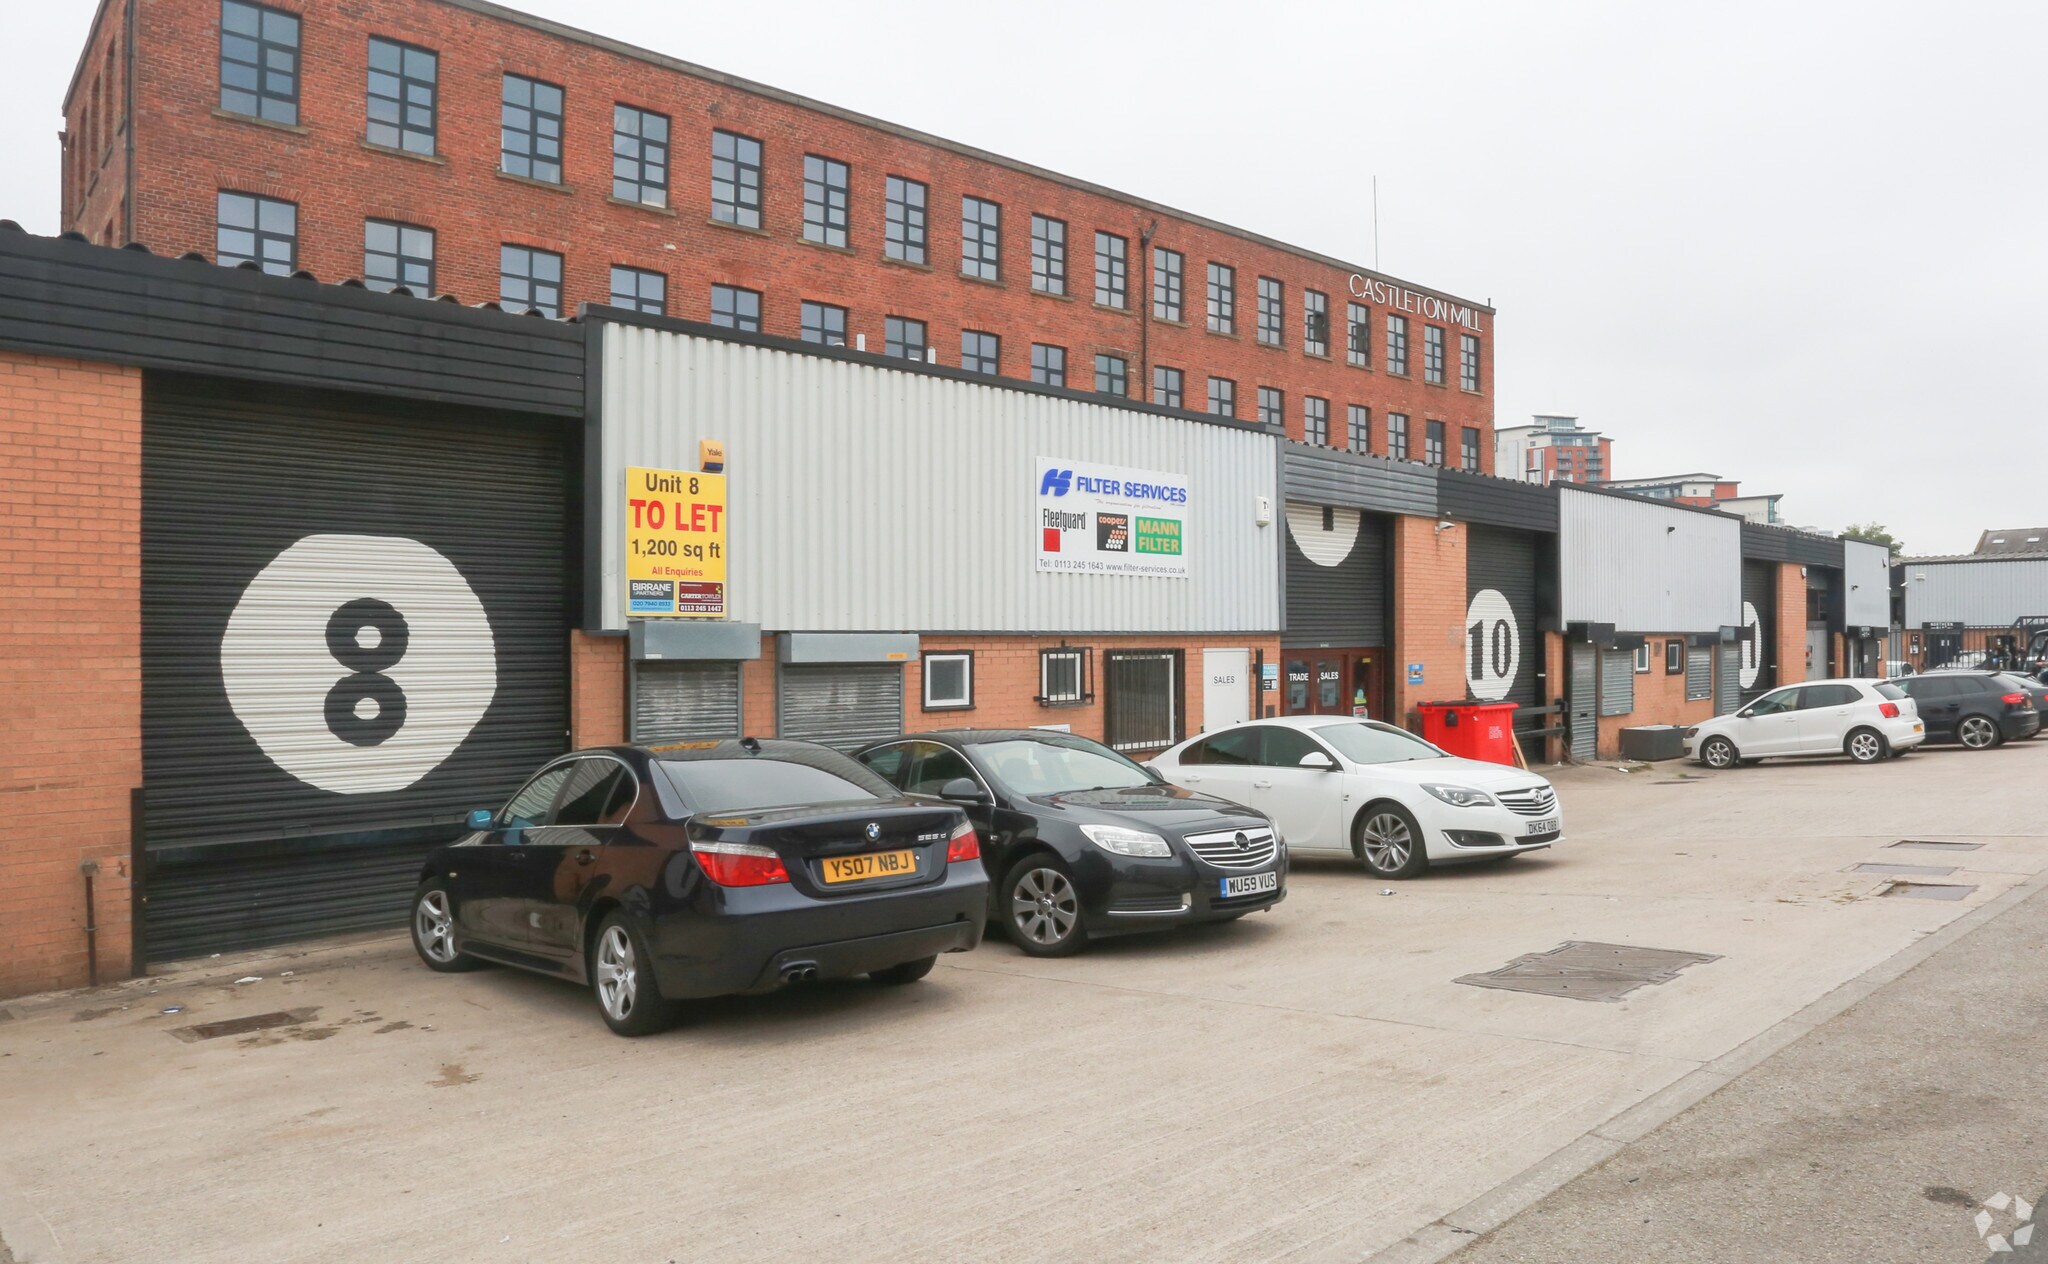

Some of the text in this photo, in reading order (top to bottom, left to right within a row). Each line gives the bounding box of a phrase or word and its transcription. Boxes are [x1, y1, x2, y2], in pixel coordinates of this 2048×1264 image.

[1350, 273, 1483, 333] CASTLETON MILL
[707, 448, 722, 457] Yale
[645, 473, 699, 495] Unit 8
[1077, 476, 1120, 495] FILTER
[1124, 481, 1187, 503] SERVICES
[629, 499, 723, 533] TO LET
[1043, 508, 1086, 532] Fleetguard
[1138, 519, 1179, 536] MANN
[632, 538, 721, 561] 1,200 sq ft
[1138, 536, 1179, 552] FILTER
[651, 566, 703, 578] All Enquiries
[1039, 559, 1052, 568] Tel:
[1054, 560, 1072, 569] 0113
[1073, 561, 1086, 570] 245
[1088, 561, 1104, 571] 1643
[632, 583, 671, 592] BIRRANE
[1469, 619, 1512, 680] 10
[324, 597, 409, 747] 8
[1213, 675, 1235, 685] SALES
[1289, 671, 1339, 682] TRADE SALES
[831, 853, 909, 878] YS07 NBJ
[1228, 873, 1276, 894] WU59 VUS
